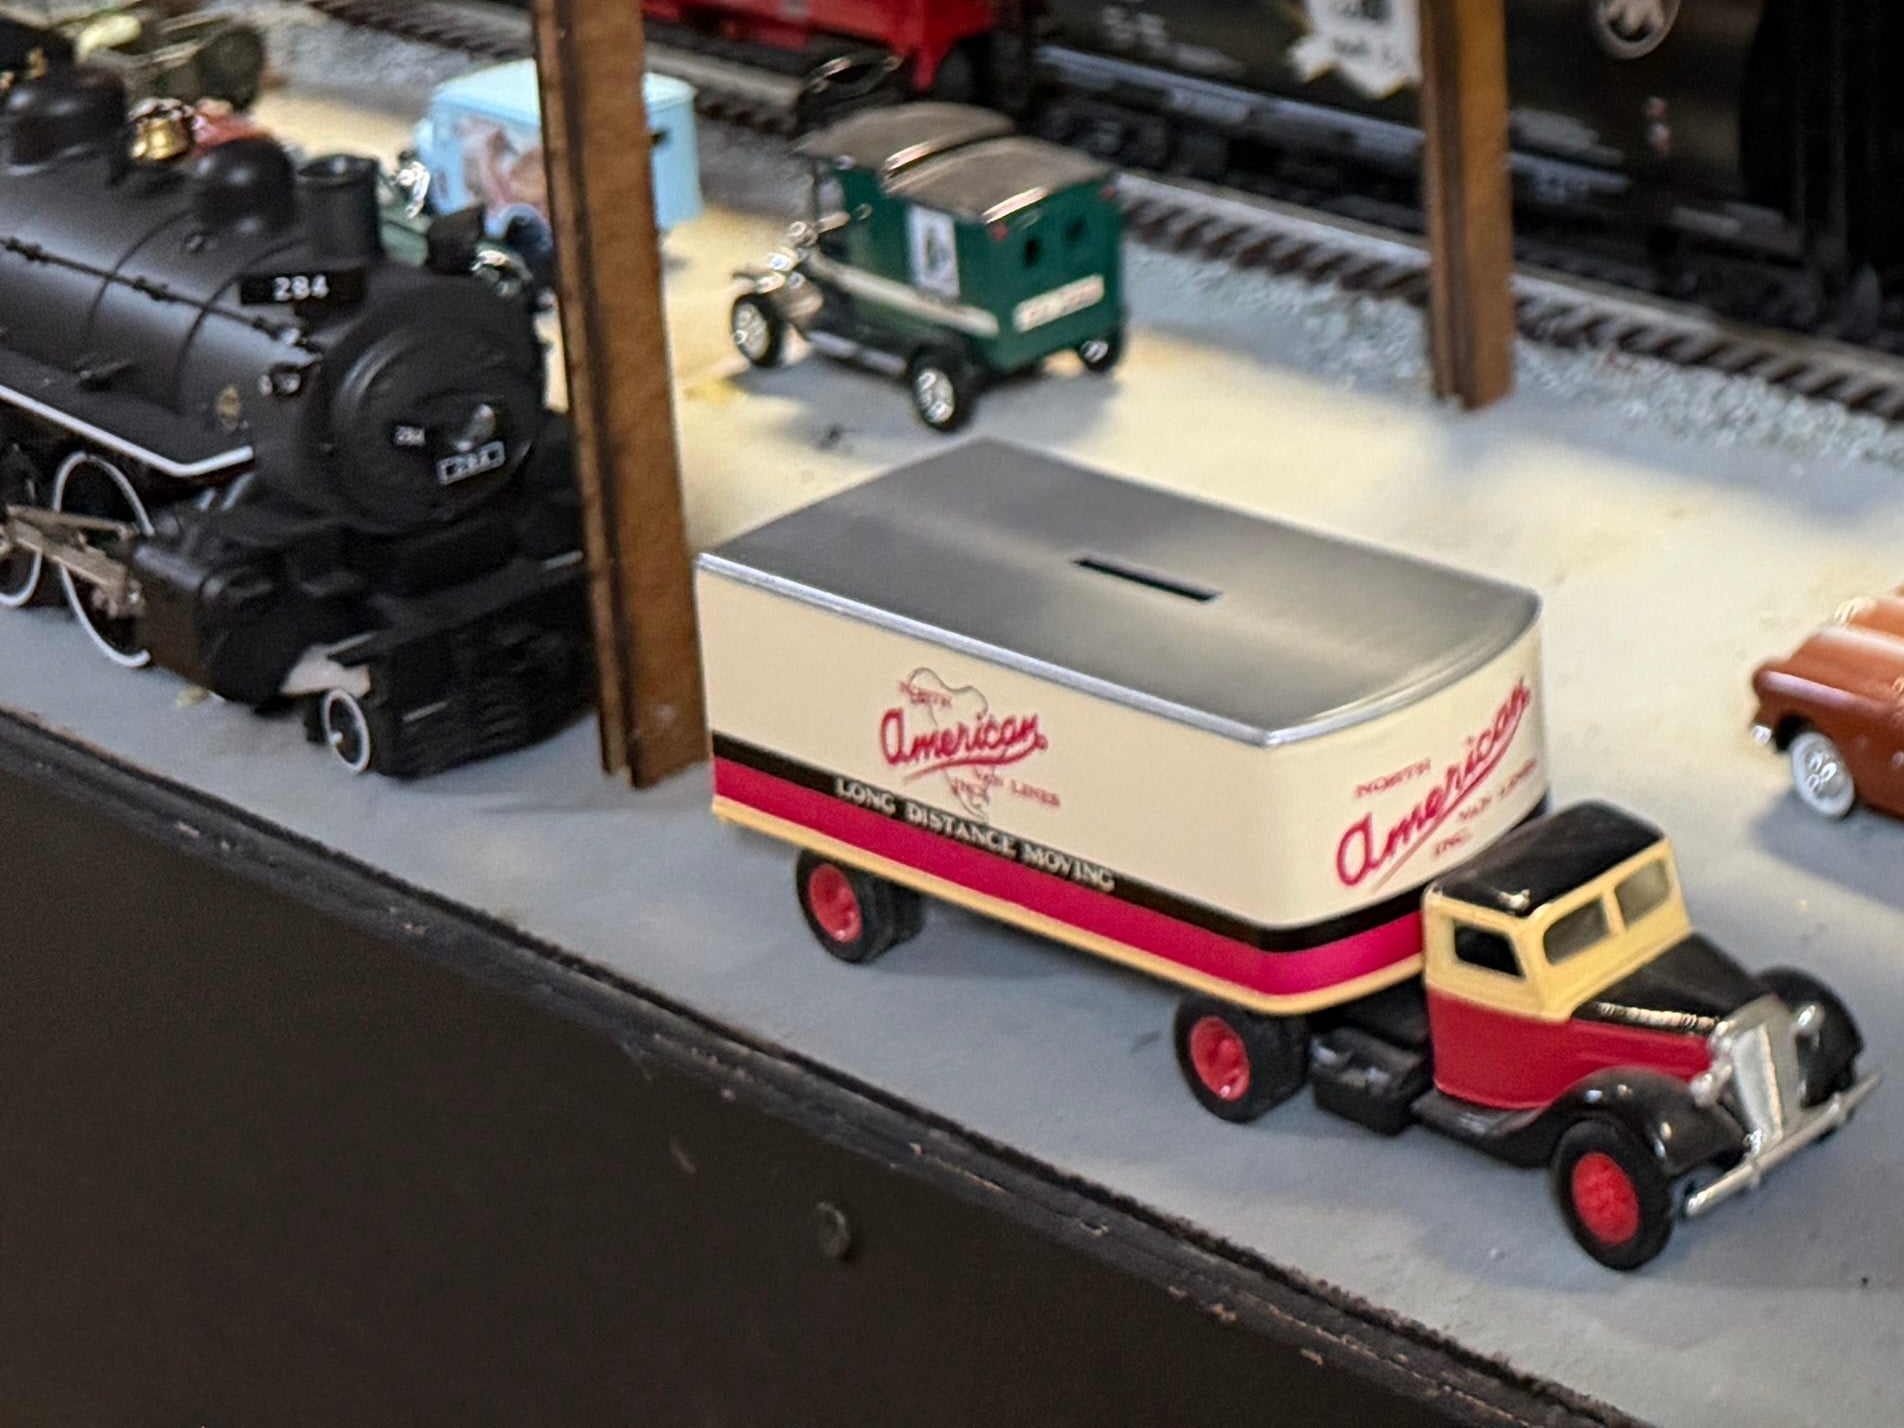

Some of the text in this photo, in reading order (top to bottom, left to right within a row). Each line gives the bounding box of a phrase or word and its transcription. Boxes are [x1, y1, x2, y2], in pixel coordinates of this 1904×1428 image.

[273, 274, 329, 302] 284
[880, 707, 1048, 768] American
[1336, 678, 1531, 887] American
[835, 777, 1116, 894] LONG DISTANCE MOVING
